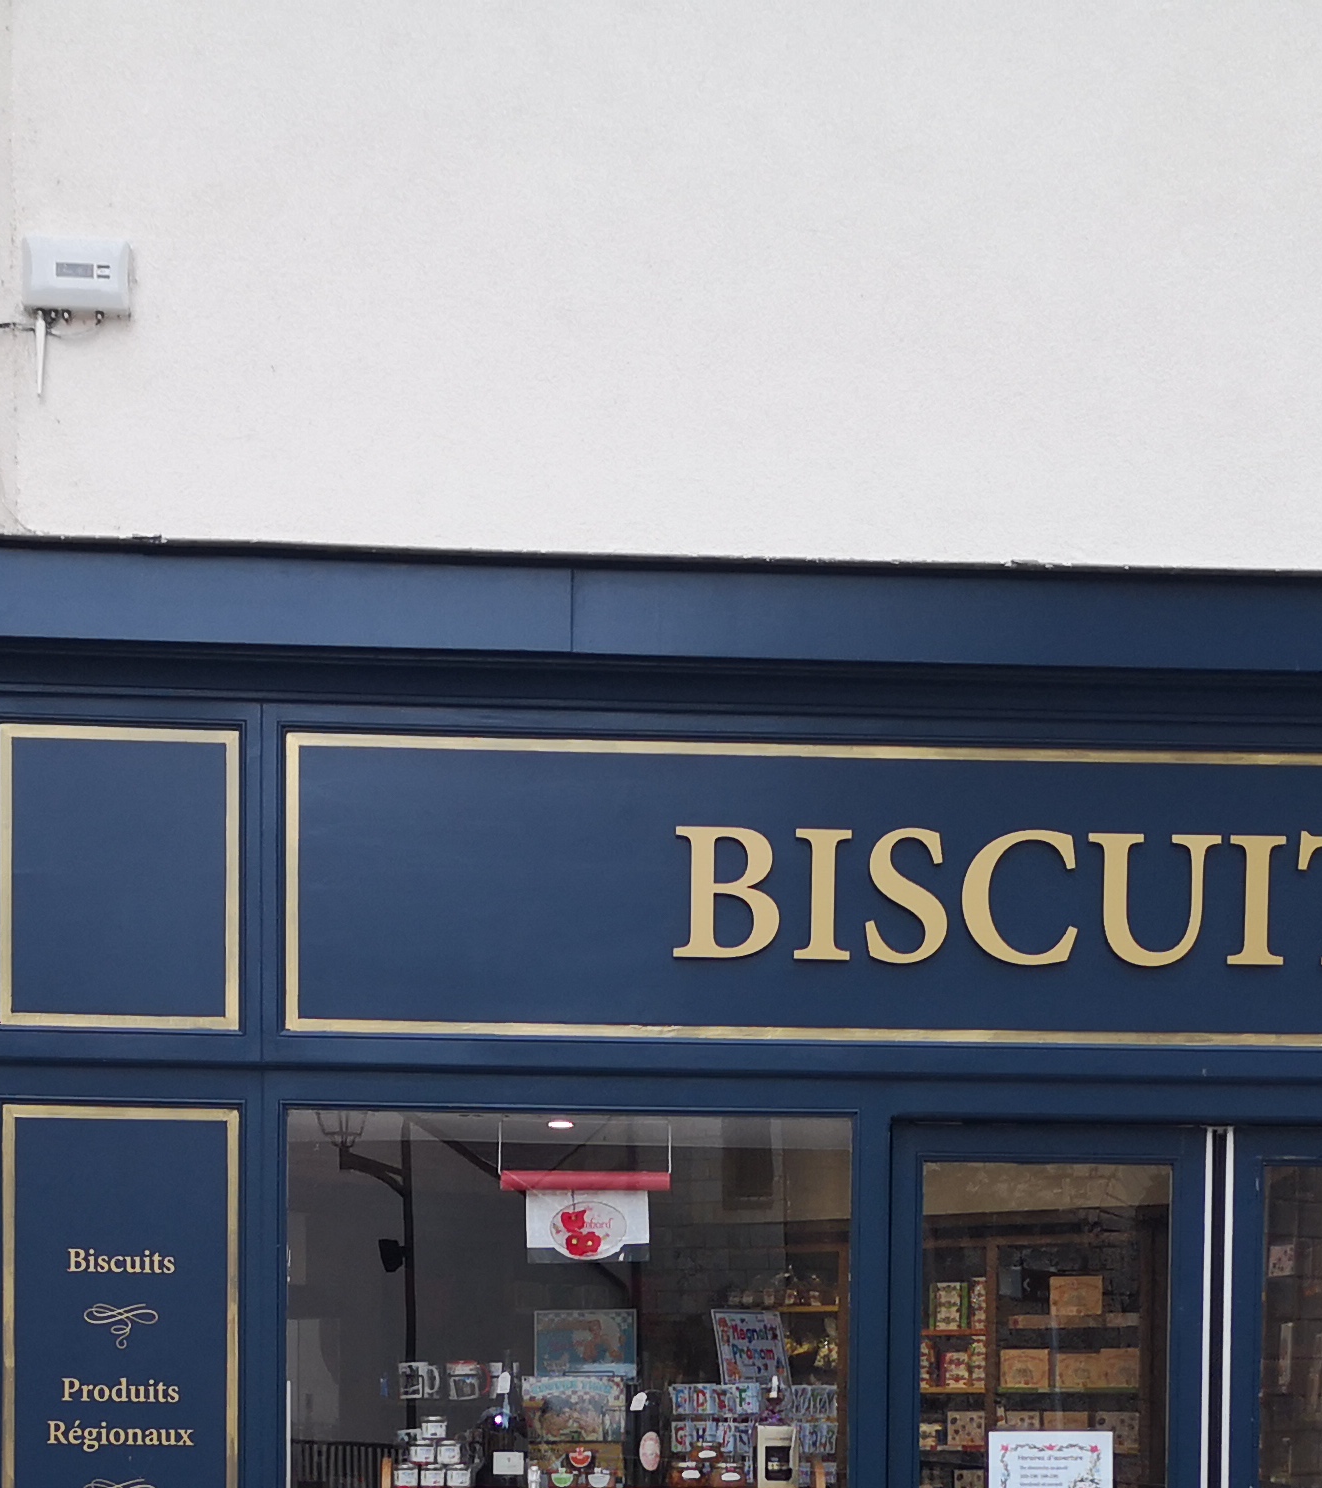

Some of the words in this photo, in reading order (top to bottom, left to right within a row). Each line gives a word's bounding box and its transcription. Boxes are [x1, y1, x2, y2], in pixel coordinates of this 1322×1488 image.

[67, 1248, 175, 1275] Biscuits
[61, 1377, 180, 1403] Produits
[46, 1420, 194, 1451] Régionaux
